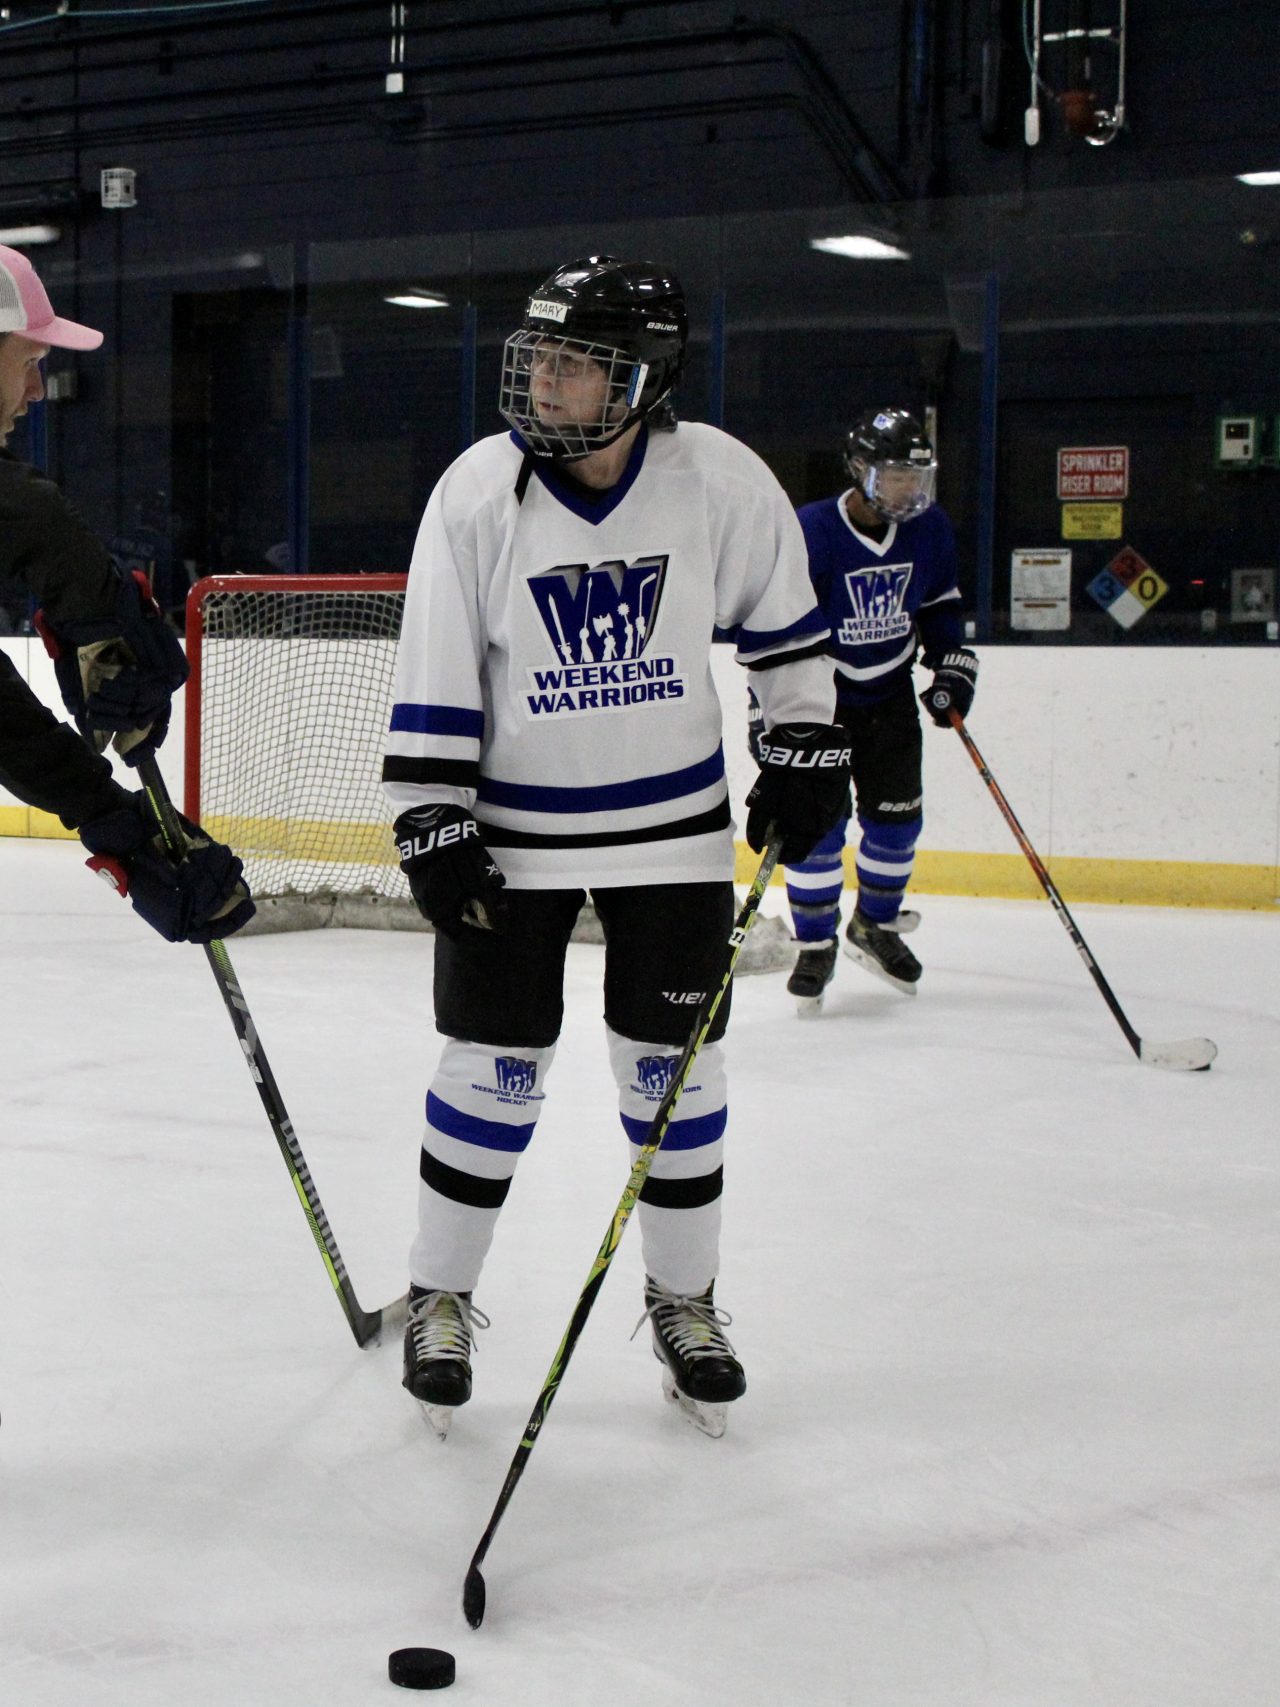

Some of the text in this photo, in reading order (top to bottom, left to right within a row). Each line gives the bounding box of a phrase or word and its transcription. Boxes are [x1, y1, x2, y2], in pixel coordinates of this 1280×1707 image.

[531, 302, 563, 318] MARY
[646, 322, 679, 332] BAUER
[1062, 453, 1124, 472] SPRINKLER
[1062, 475, 1124, 493] RISER ROOM
[847, 615, 906, 631] WEEKEND
[842, 626, 908, 643] WARRIORS
[533, 657, 675, 691] WEEKEND
[526, 678, 684, 715] WARRIORS
[760, 744, 852, 768] BAUER
[399, 820, 480, 861] AUER
[471, 1083, 511, 1098] WEEKEND
[496, 1096, 528, 1106] HOCKEY
